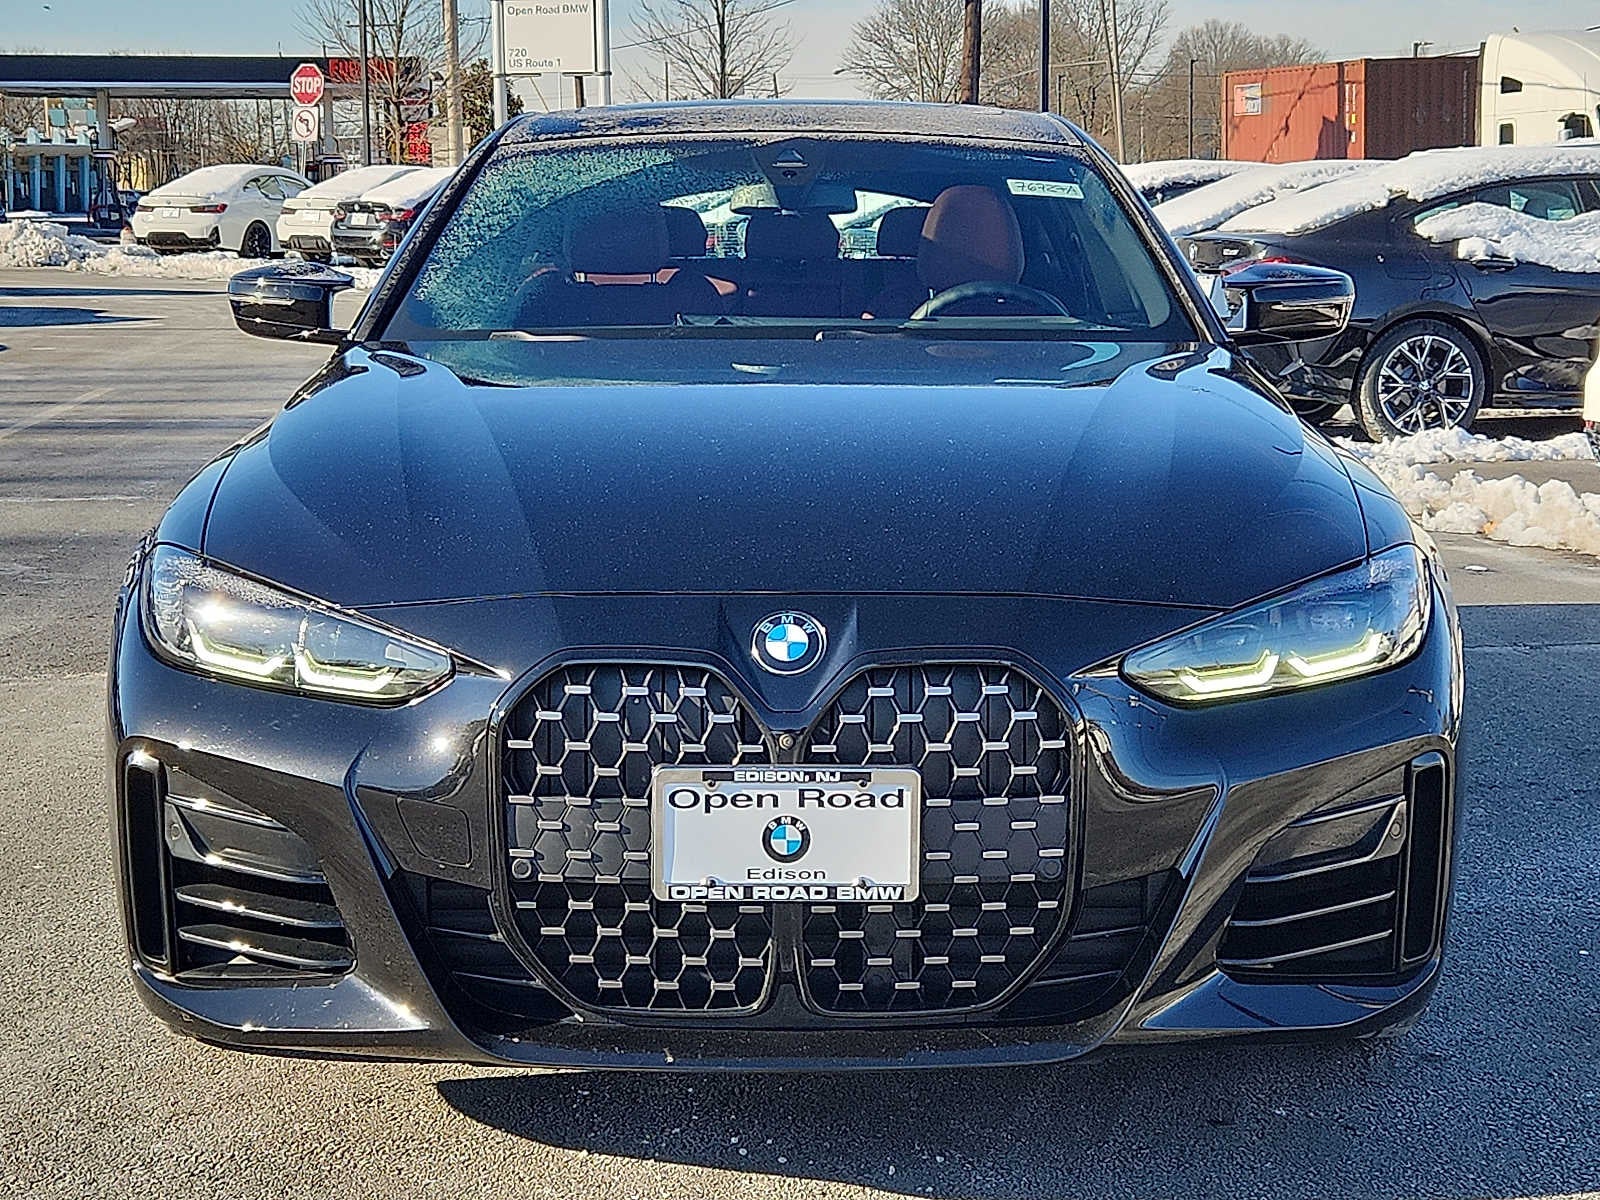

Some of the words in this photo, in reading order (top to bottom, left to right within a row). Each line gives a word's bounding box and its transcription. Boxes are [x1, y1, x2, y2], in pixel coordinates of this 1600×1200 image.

[507, 6, 533, 16] Open
[535, 5, 560, 14] Road
[562, 4, 588, 13] BMW
[508, 48, 527, 57] 720
[508, 59, 523, 68] US
[525, 59, 553, 68] Route
[556, 58, 561, 66] 1
[293, 76, 322, 94] STOP
[760, 615, 816, 634] BMW
[733, 772, 810, 782] EDISON,
[815, 772, 842, 782] NJ
[668, 788, 779, 814] Open
[798, 788, 905, 809] Road
[768, 816, 807, 831] BMW
[746, 868, 827, 880] Edison
[670, 886, 750, 900] OPEN
[752, 886, 829, 900] ROAD
[836, 886, 903, 900] BMW
